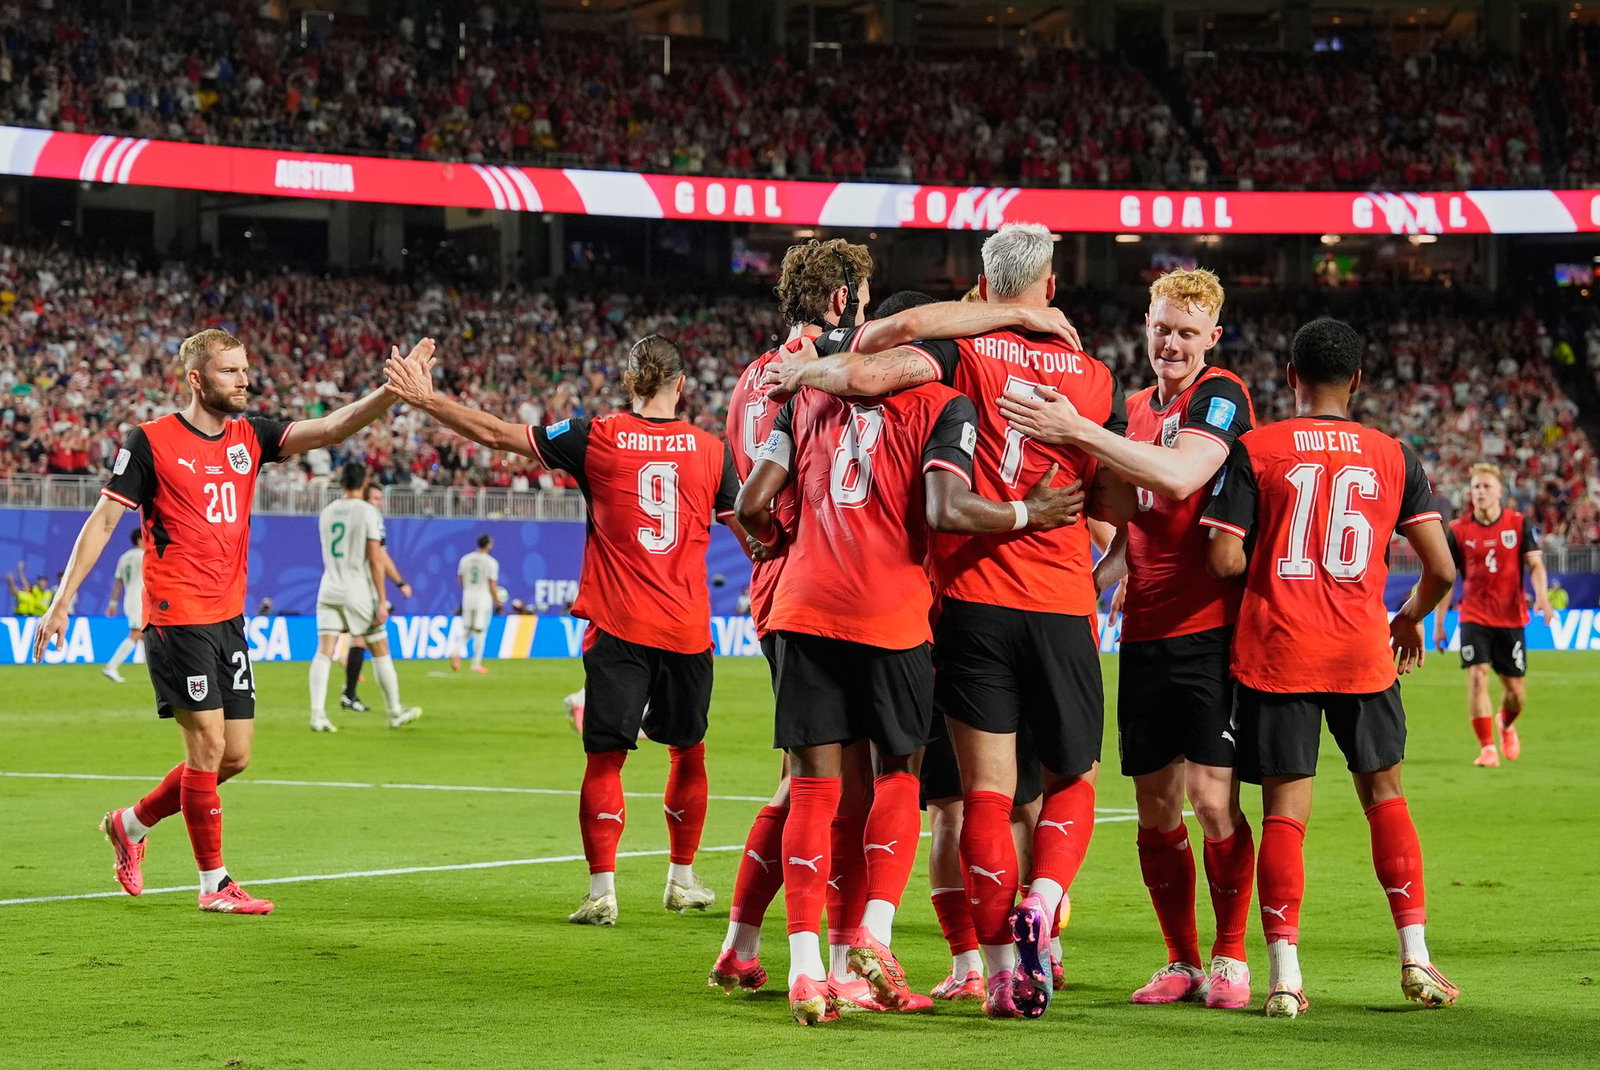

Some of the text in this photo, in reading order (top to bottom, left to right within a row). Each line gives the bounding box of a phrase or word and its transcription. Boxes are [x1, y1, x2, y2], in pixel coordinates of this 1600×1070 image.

[675, 181, 782, 217] GOAL
[1120, 195, 1233, 228] GOAL
[1352, 196, 1467, 228] GOAL
[973, 337, 1083, 374] ARNAUTOVIC
[617, 431, 697, 452] SABITZER
[831, 402, 885, 510] 8
[1293, 430, 1362, 454] MWENE
[203, 481, 238, 524] 20
[637, 461, 679, 555] 9
[331, 522, 346, 557] 2
[1277, 463, 1379, 583] 16
[1485, 548, 1498, 573] 4
[0, 616, 95, 664] VSA
[243, 615, 292, 662] SA
[391, 615, 469, 659] VISA
[710, 615, 761, 657] VIS
[227, 651, 255, 690] 2
[1511, 640, 1525, 672] 4
